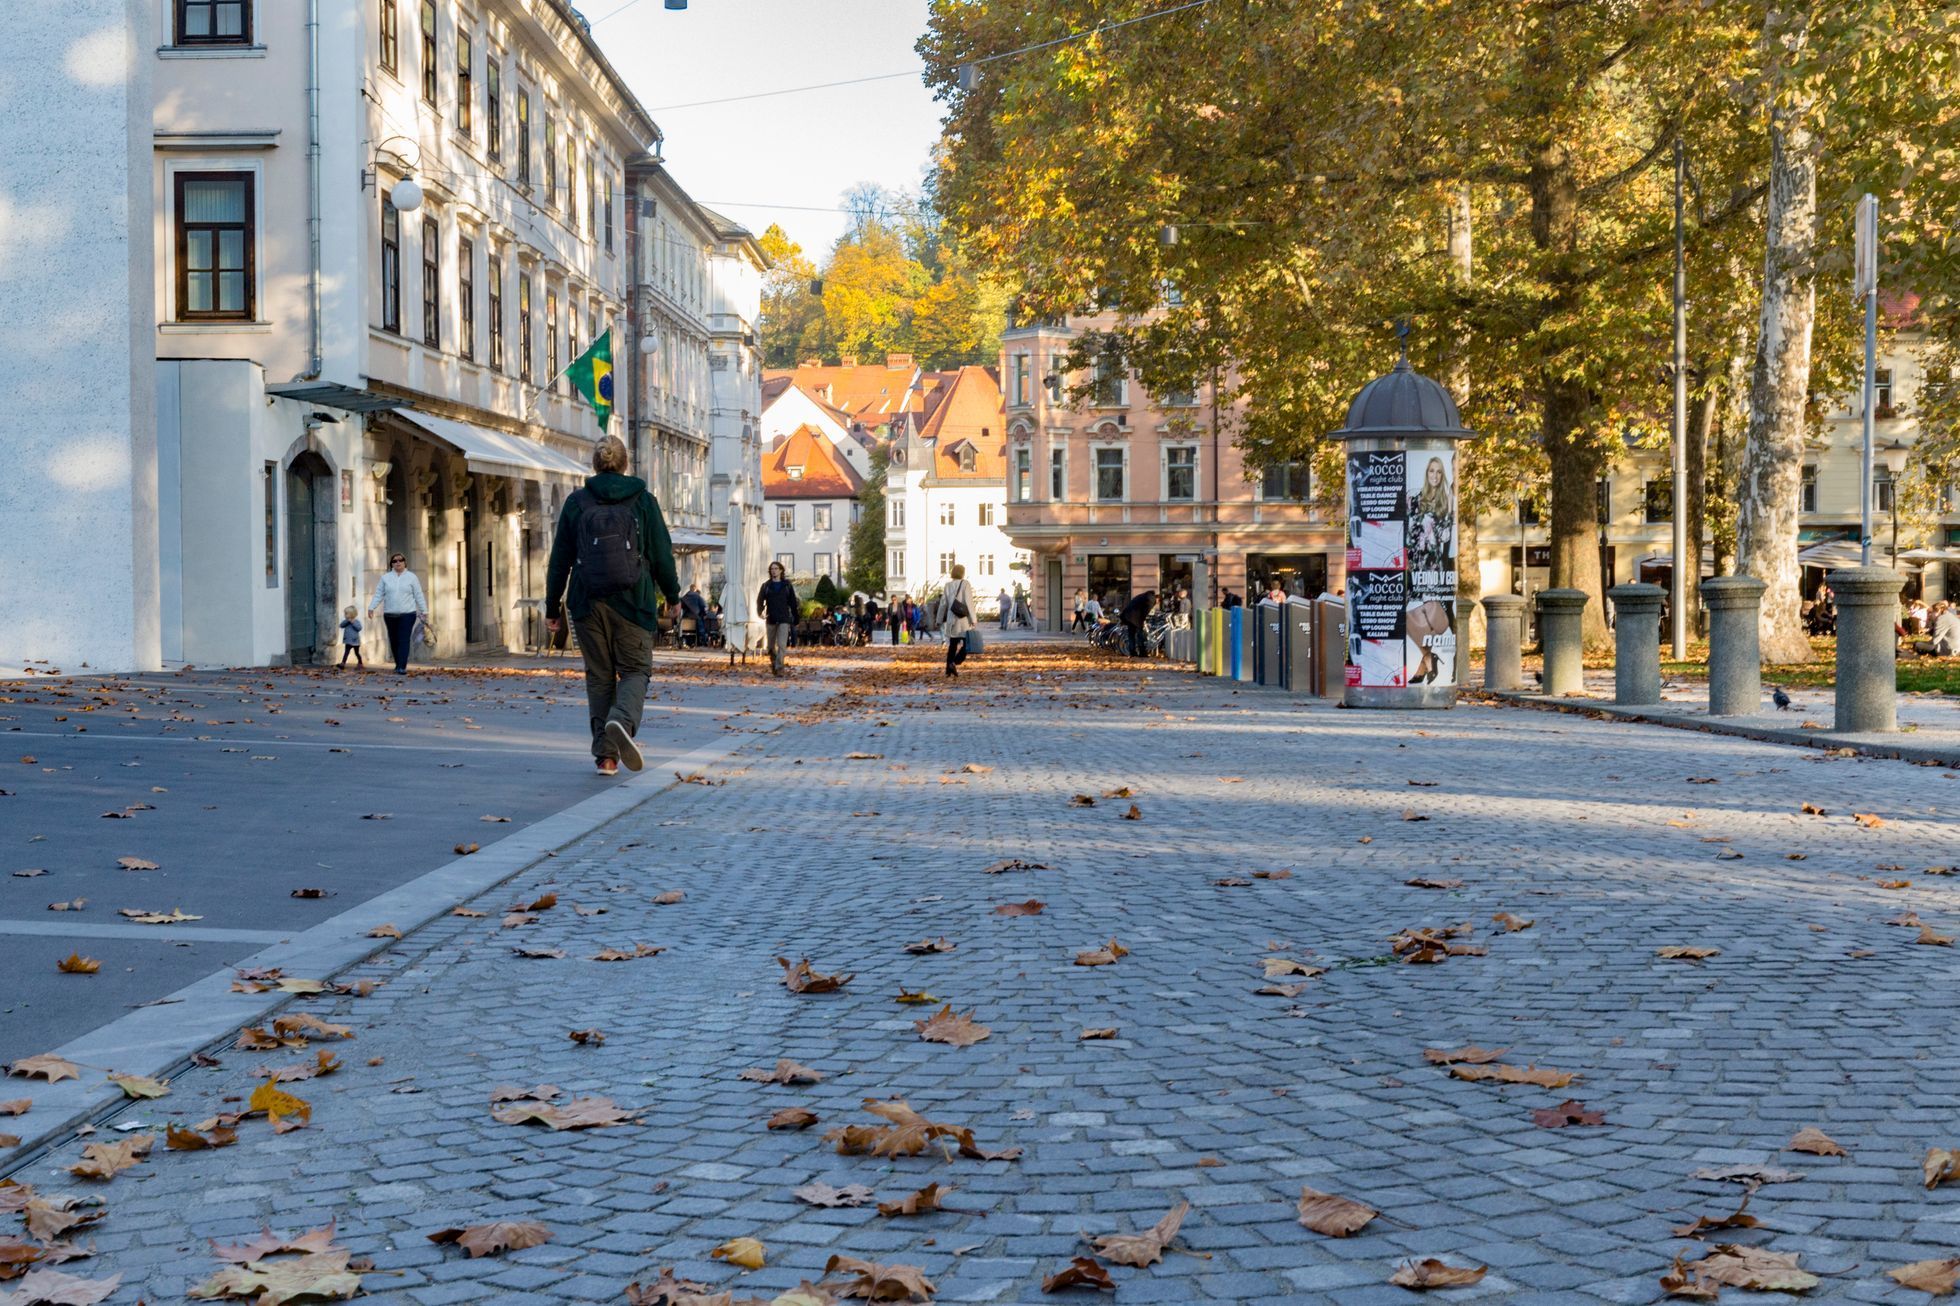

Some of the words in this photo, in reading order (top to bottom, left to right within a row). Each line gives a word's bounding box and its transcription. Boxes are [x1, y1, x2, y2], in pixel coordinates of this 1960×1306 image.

[1370, 464, 1404, 476] ROCCO
[1370, 476, 1387, 484] night
[1411, 571, 1438, 585] VEDNO
[1370, 583, 1404, 594] ROCCO
[1370, 594, 1387, 603] night
